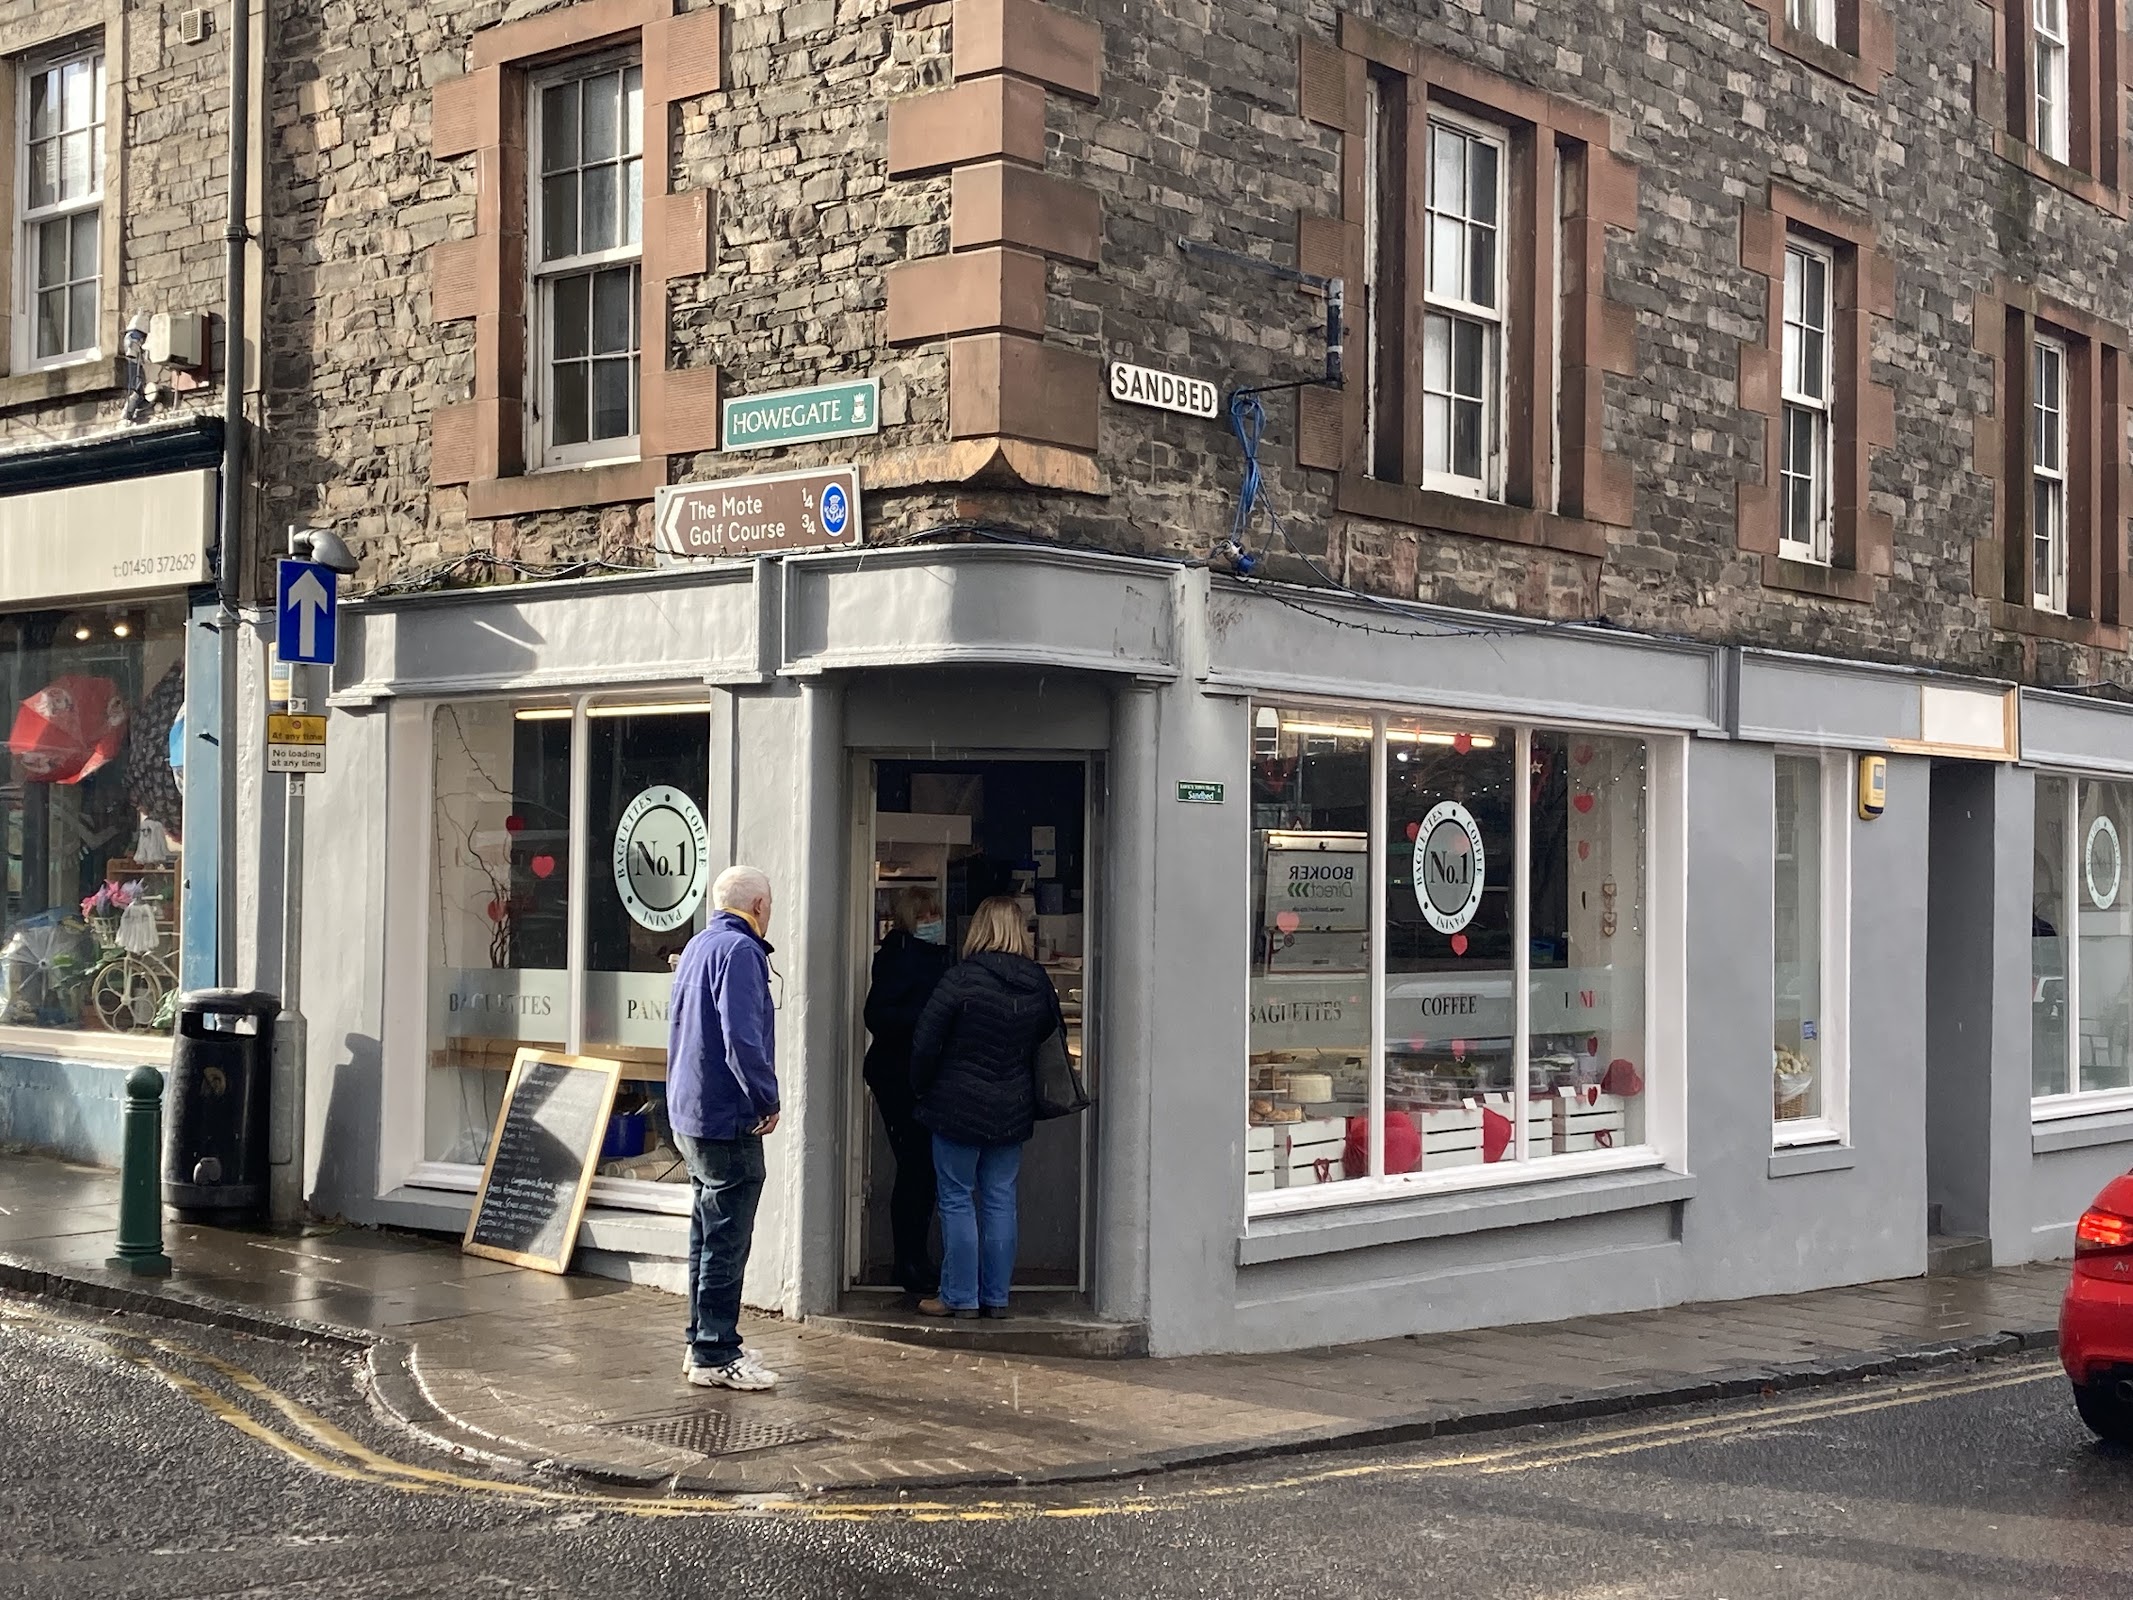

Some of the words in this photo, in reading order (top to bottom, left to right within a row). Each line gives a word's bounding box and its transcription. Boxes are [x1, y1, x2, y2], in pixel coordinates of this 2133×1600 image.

[1116, 366, 1212, 412] SANDBED
[733, 400, 842, 435] HOWEGATE
[689, 501, 716, 520] The
[722, 495, 763, 517] Mote
[689, 523, 723, 546] Golf
[728, 522, 786, 541] Course
[113, 558, 154, 577] t:01450
[157, 553, 196, 573] 372629
[285, 733, 300, 741] any
[272, 749, 286, 757] No
[288, 750, 321, 759] loading
[616, 793, 652, 879] BAGUETTES
[685, 805, 707, 868] COFFEE
[1415, 808, 1443, 886] BAGUETTES
[1466, 820, 1483, 877] COFFEE
[634, 840, 688, 877] No.1
[1430, 851, 1470, 885] No.1
[642, 908, 682, 927] PANINI
[1436, 913, 1466, 930] PANINI
[1421, 995, 1477, 1017] COFFEE
